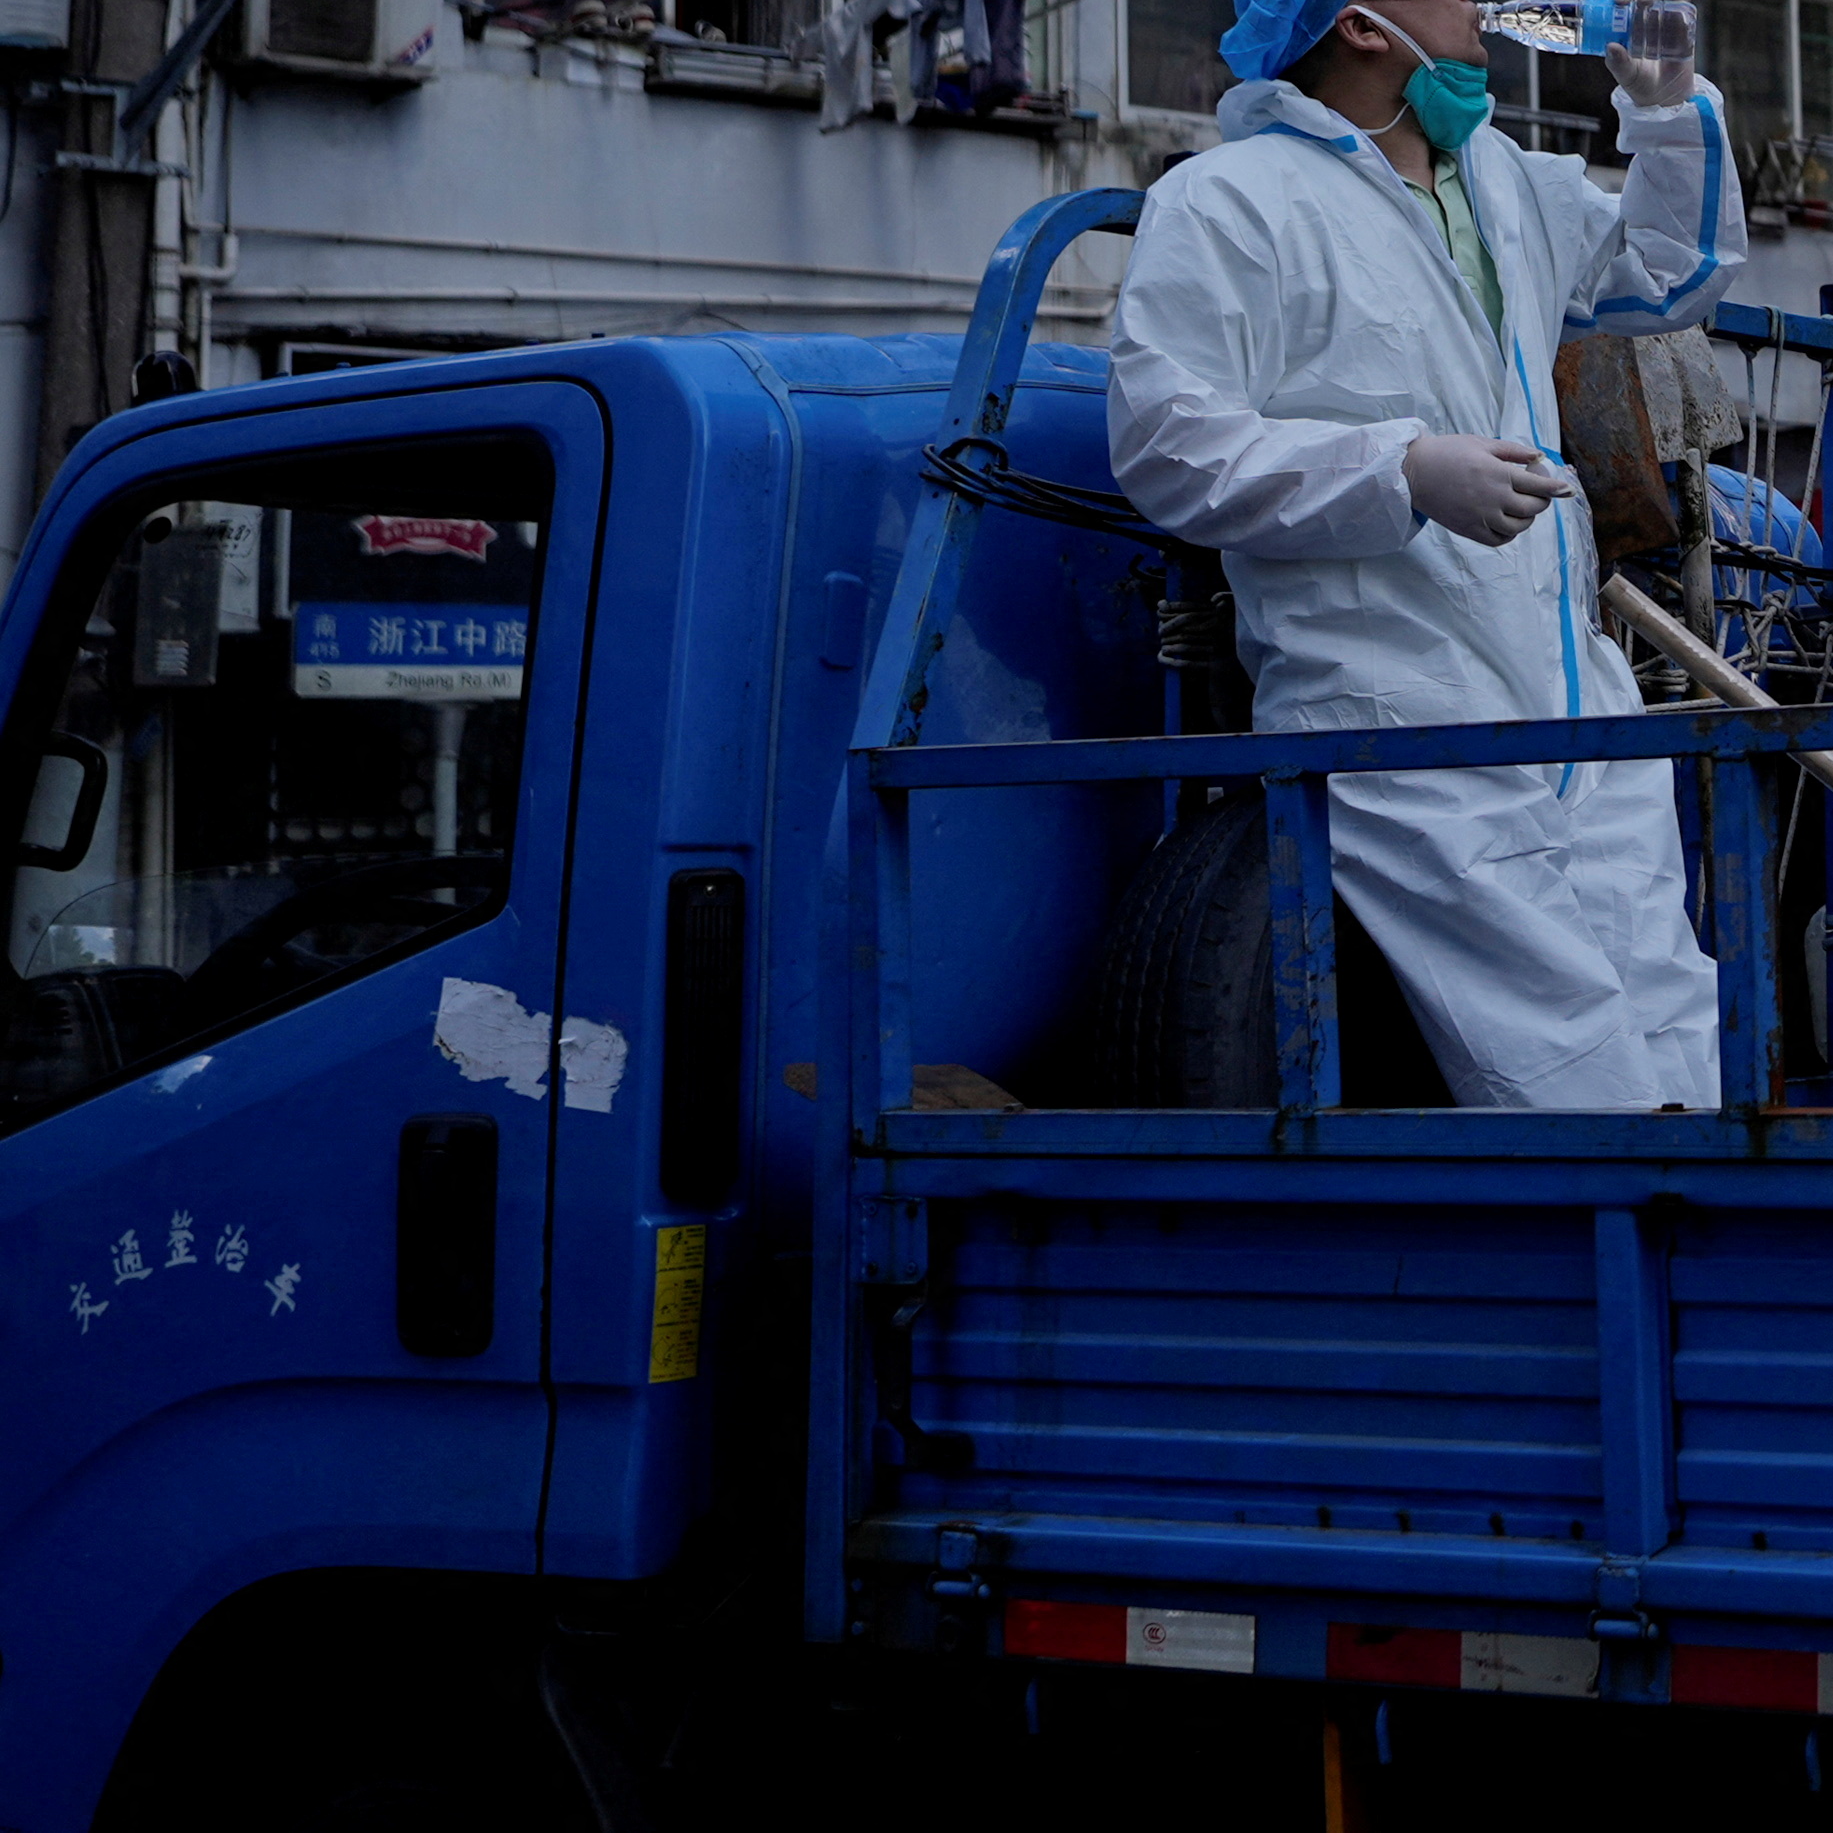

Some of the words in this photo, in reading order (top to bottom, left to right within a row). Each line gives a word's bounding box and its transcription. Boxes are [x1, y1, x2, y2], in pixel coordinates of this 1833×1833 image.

[368, 616, 527, 659] 浙江中路
[315, 669, 332, 692] S
[385, 671, 453, 690] Zhejiang
